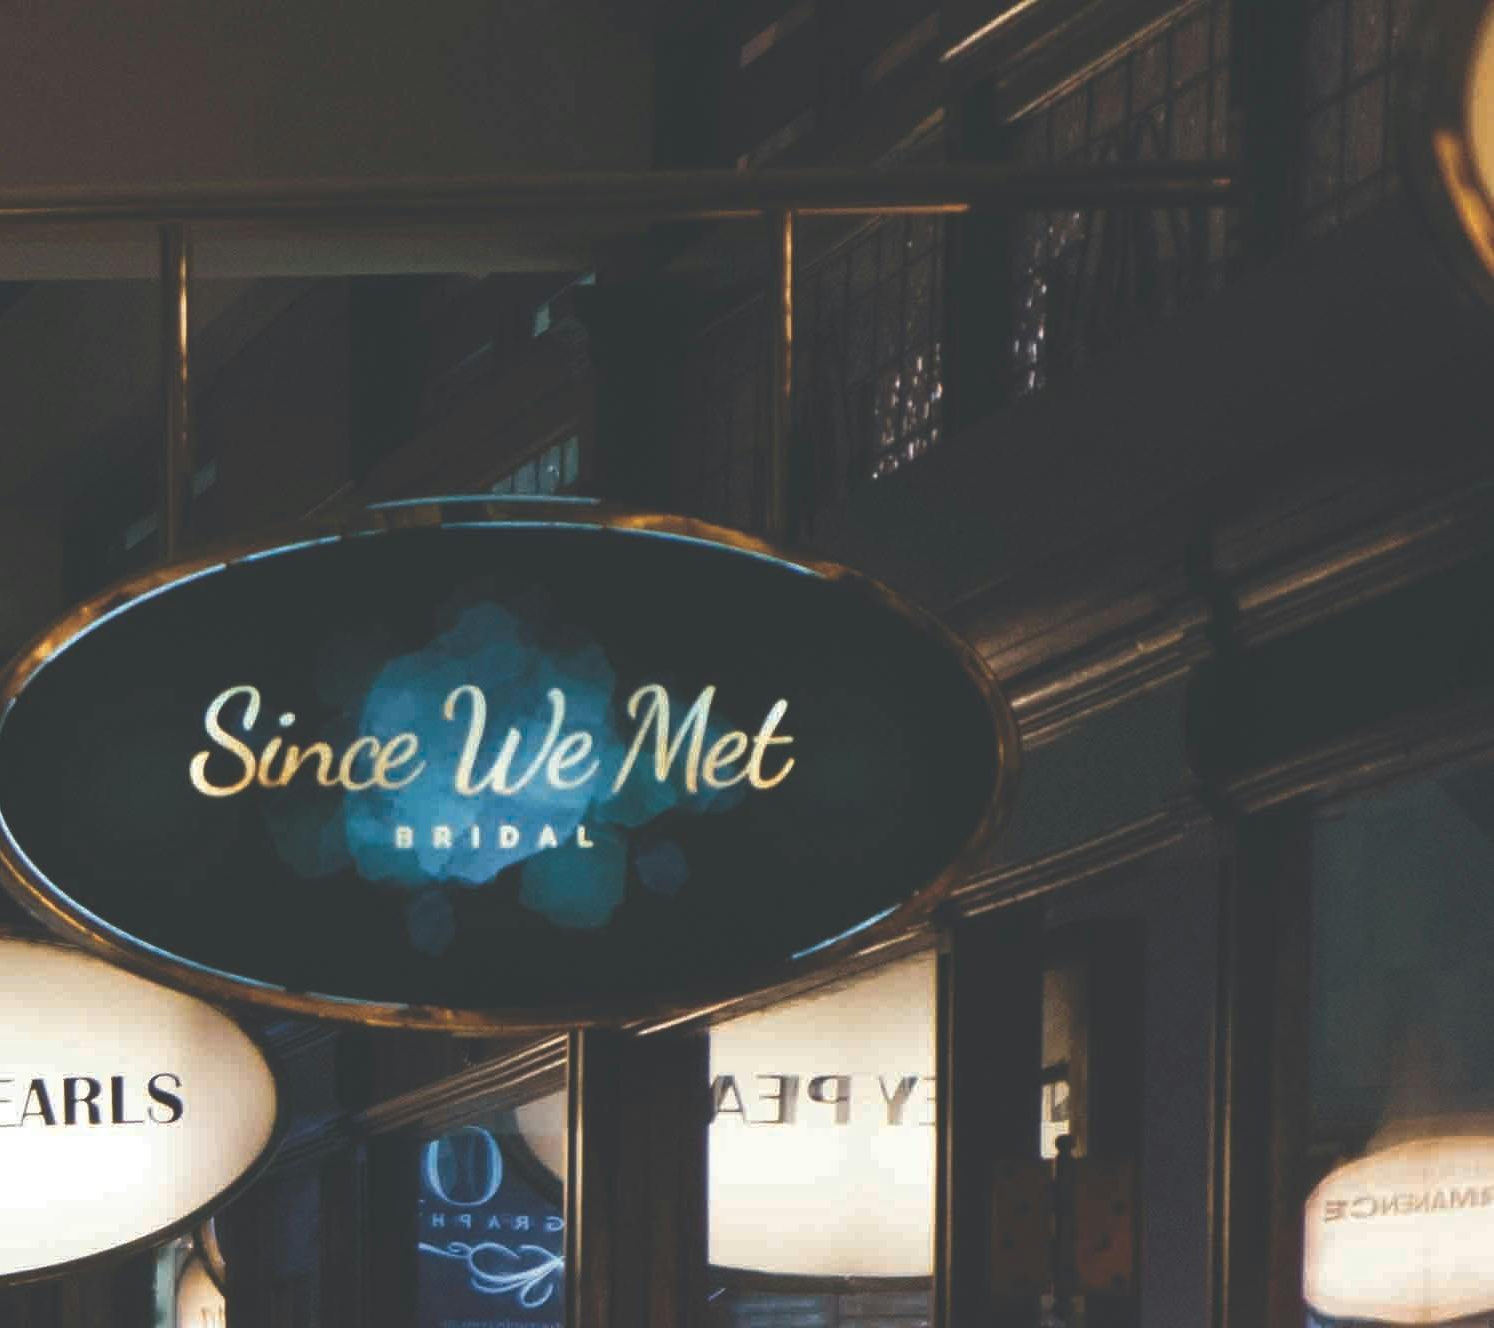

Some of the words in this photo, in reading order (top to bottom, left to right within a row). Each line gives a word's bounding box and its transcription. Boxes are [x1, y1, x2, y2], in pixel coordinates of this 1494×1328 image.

[188, 685, 427, 798] Since
[443, 684, 601, 797] We
[609, 683, 795, 795] Met
[394, 825, 595, 850] BRIDAL
